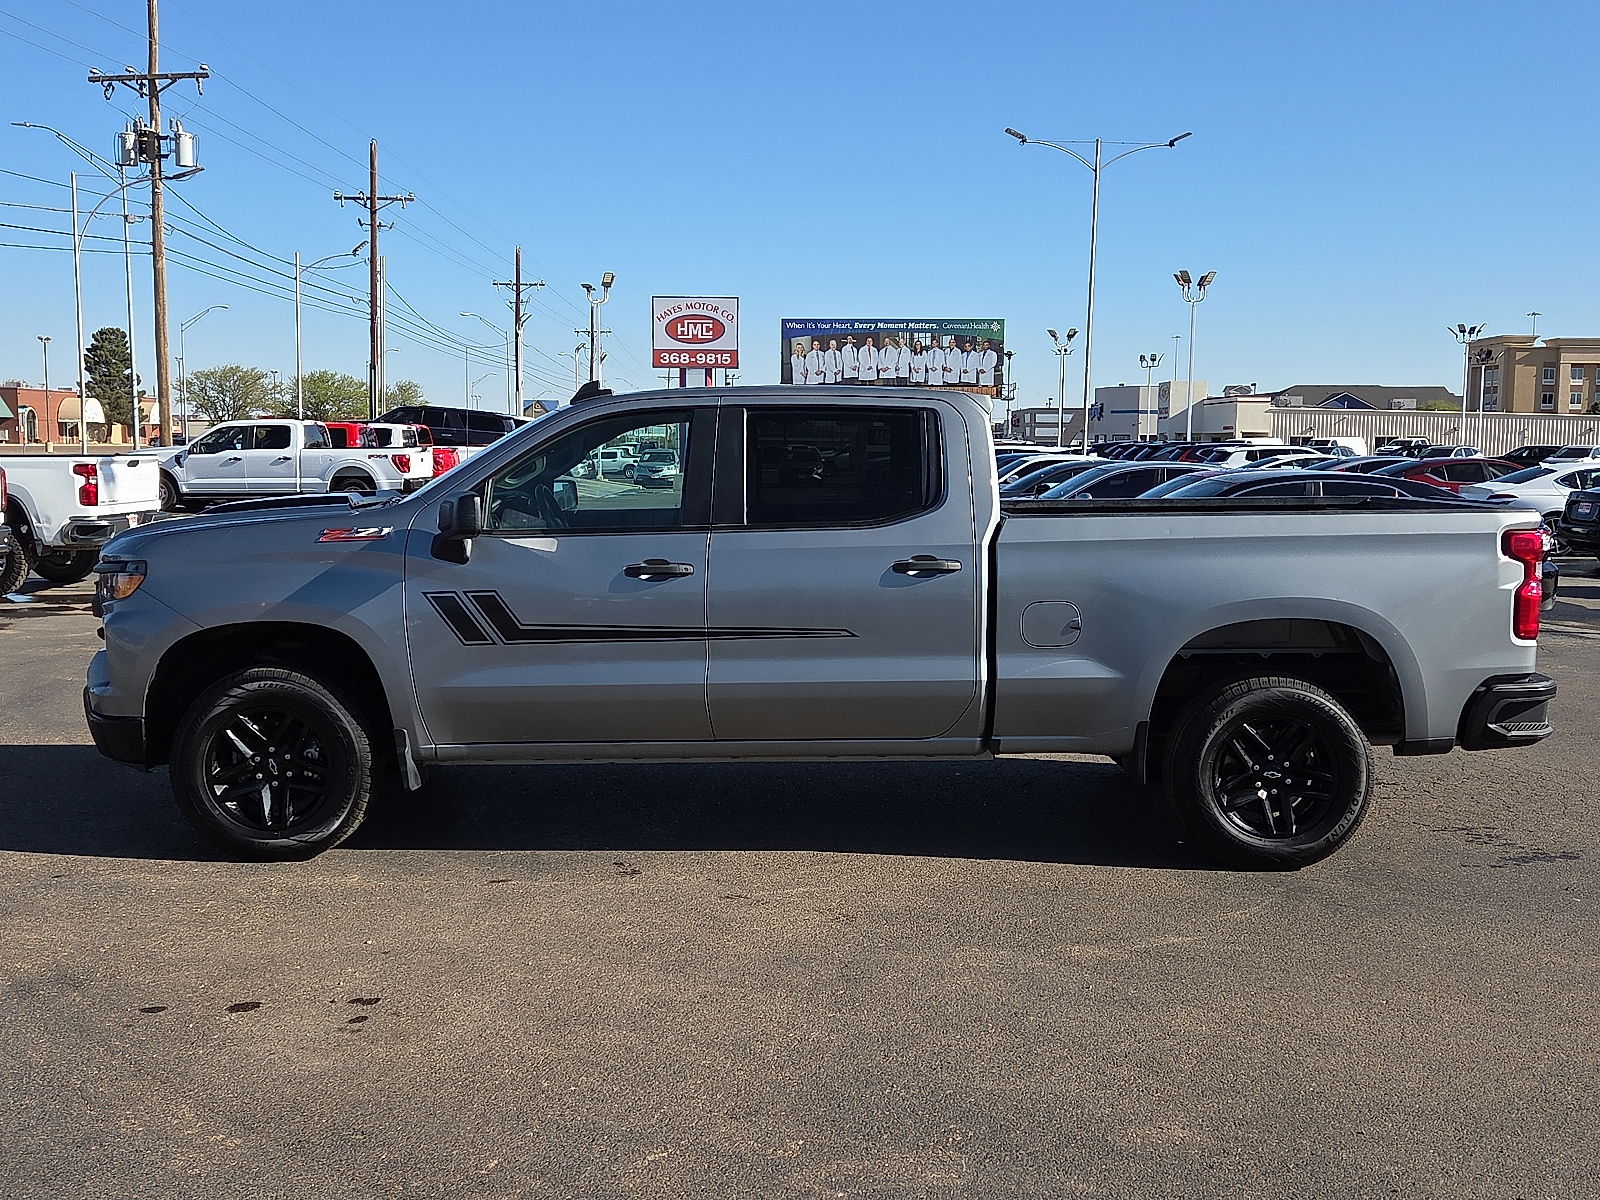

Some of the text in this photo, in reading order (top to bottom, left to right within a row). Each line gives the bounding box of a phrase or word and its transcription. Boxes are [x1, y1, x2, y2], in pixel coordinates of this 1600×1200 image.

[656, 302, 735, 323] HAYES MOTOR CO.
[677, 319, 714, 339] HMC
[785, 321, 939, 331] When It's Your Heart, Every Moment Matters.
[660, 352, 731, 365] 368-9815
